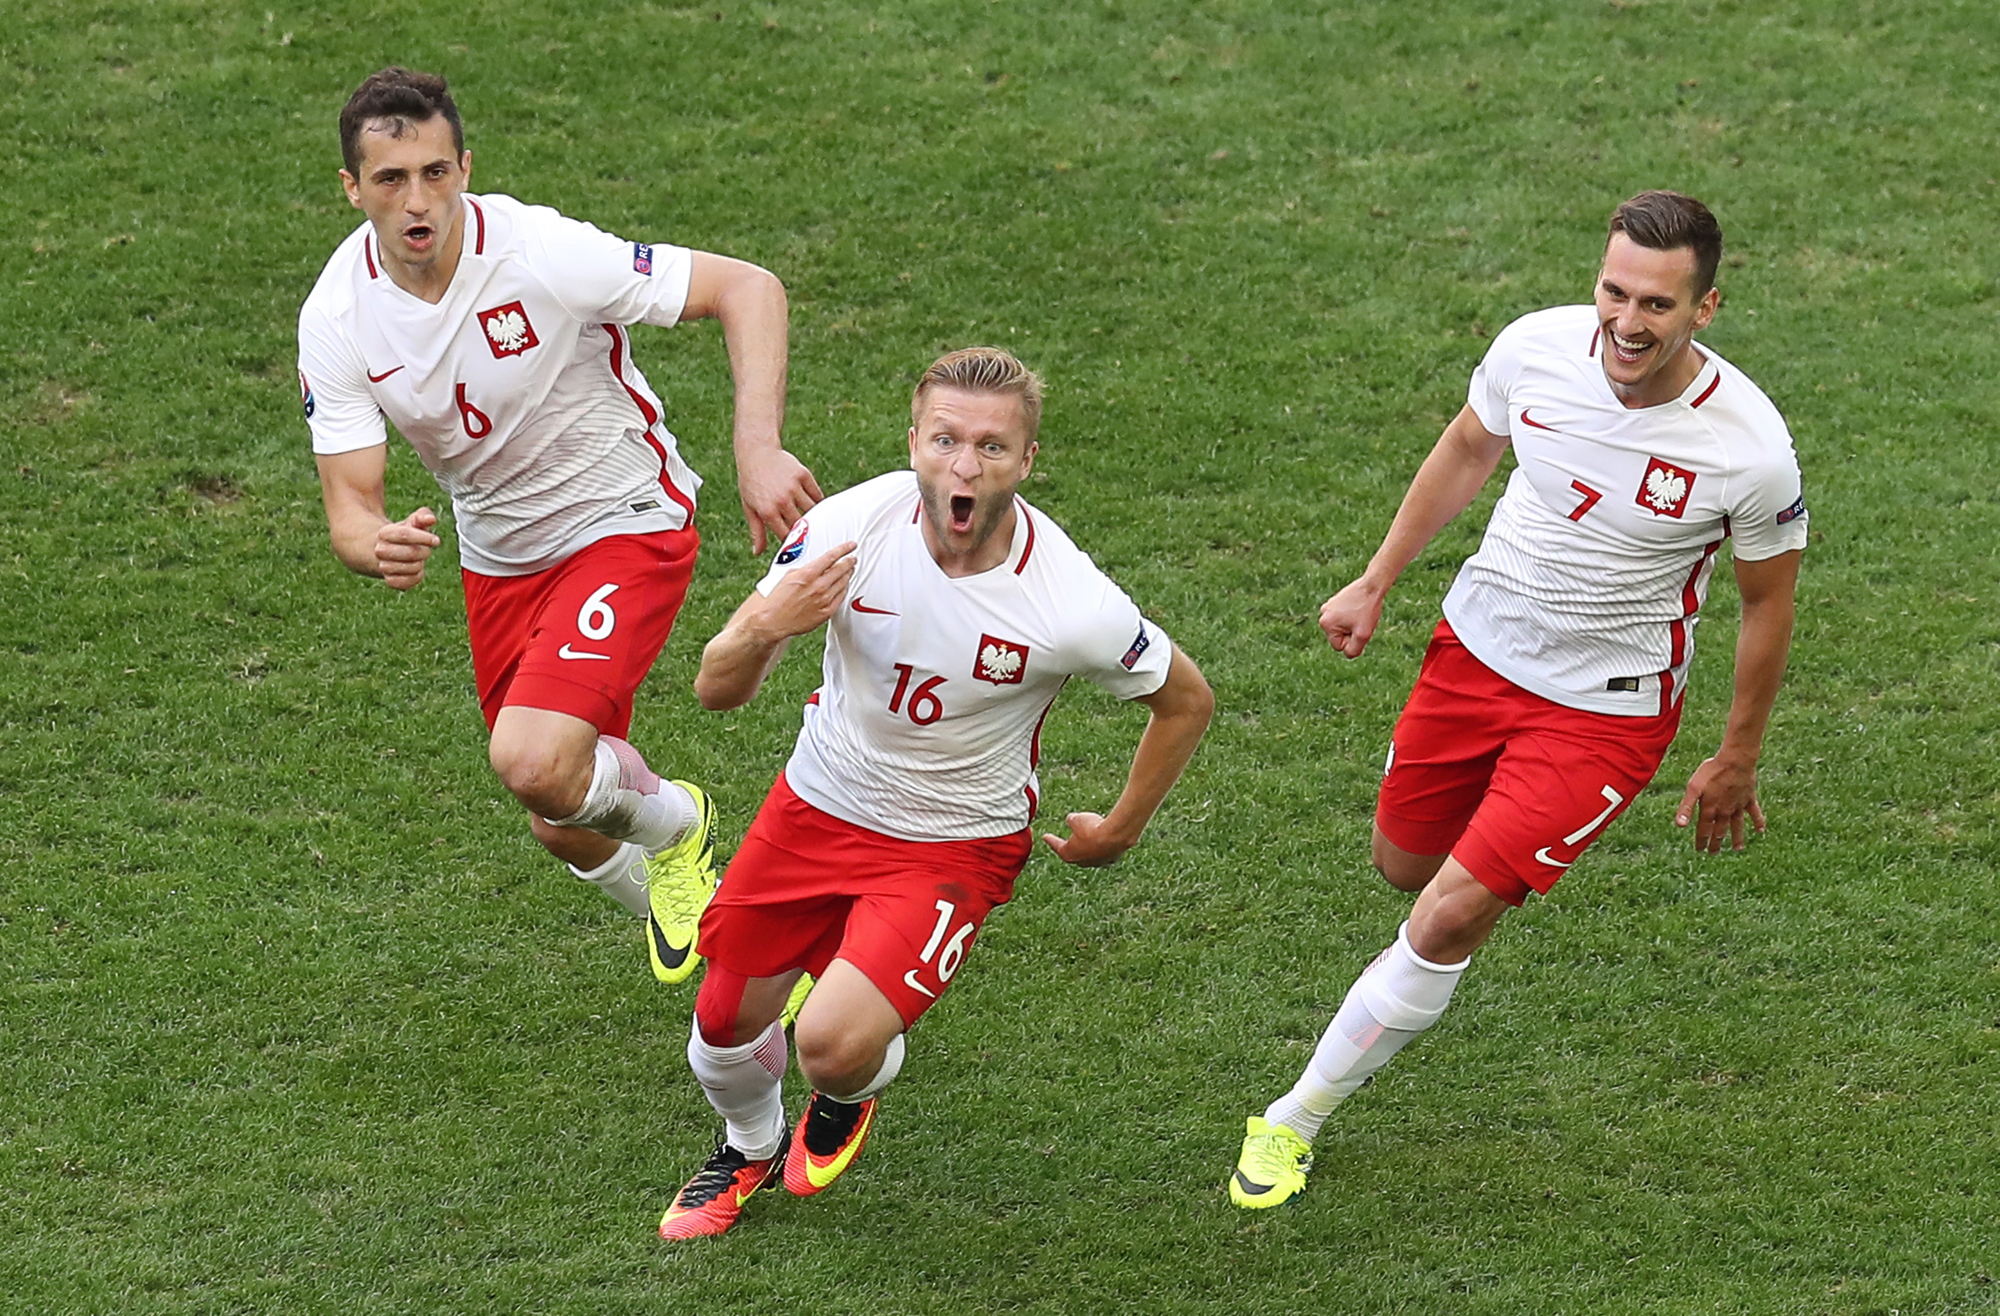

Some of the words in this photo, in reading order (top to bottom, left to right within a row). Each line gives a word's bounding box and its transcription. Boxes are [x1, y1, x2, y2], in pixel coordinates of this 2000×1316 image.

[455, 383, 493, 440] 6
[1568, 480, 1602, 522] 7
[577, 583, 618, 641] 6
[890, 664, 946, 726] 16
[1563, 784, 1625, 846] 7
[919, 899, 975, 983] 16
